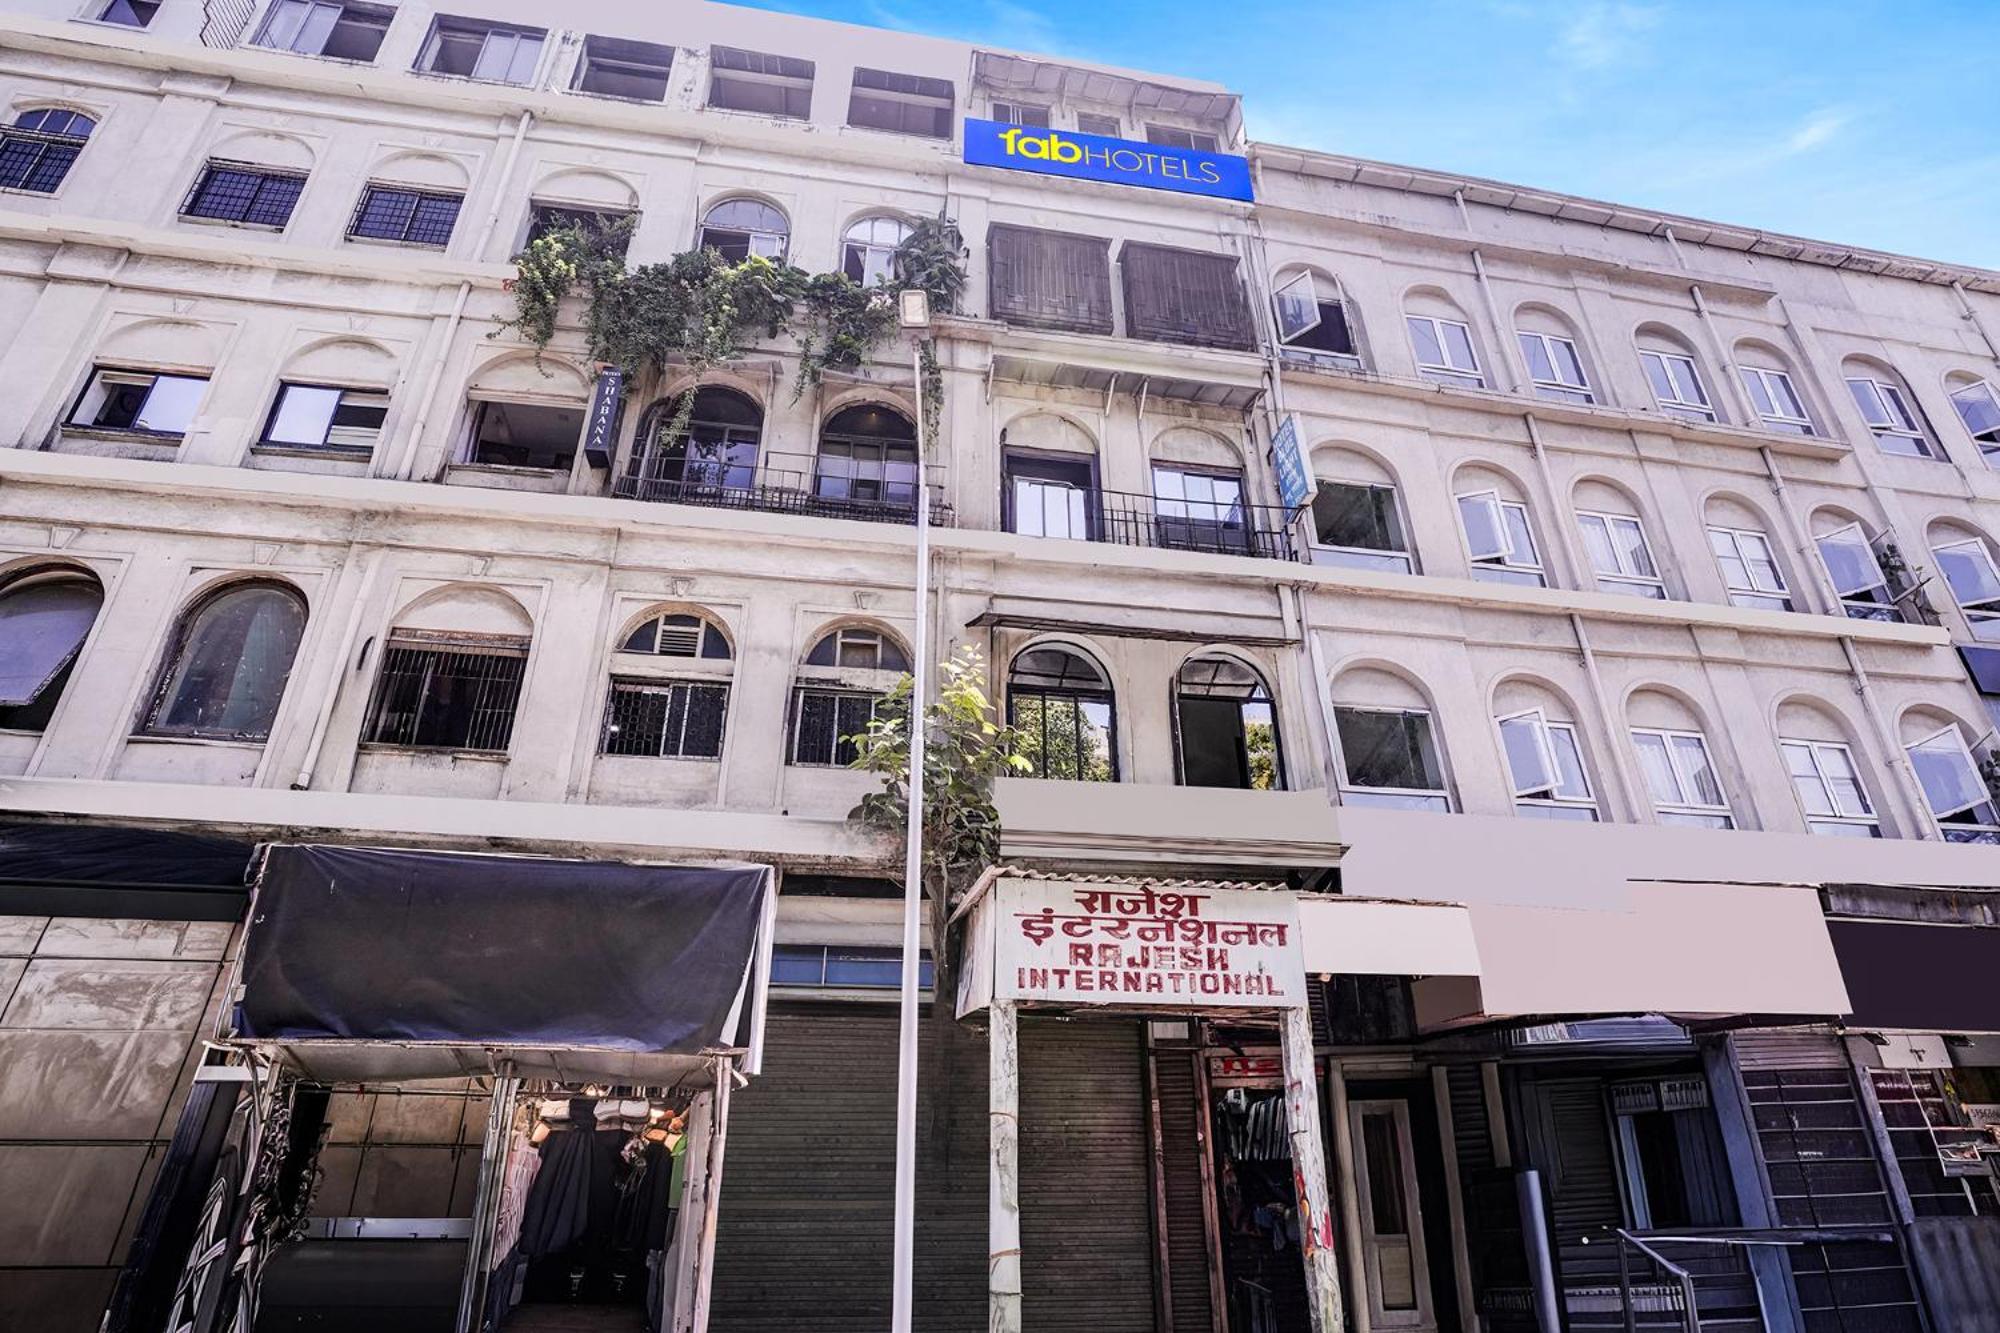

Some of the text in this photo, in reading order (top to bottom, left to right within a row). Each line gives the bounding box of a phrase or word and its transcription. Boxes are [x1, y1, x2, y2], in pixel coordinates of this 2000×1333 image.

[592, 377, 616, 445] SHABANA
[1074, 885, 1211, 918] राजेश
[1068, 942, 1229, 971] RAJESH
[1017, 967, 1285, 997] INTERNATIONAL
